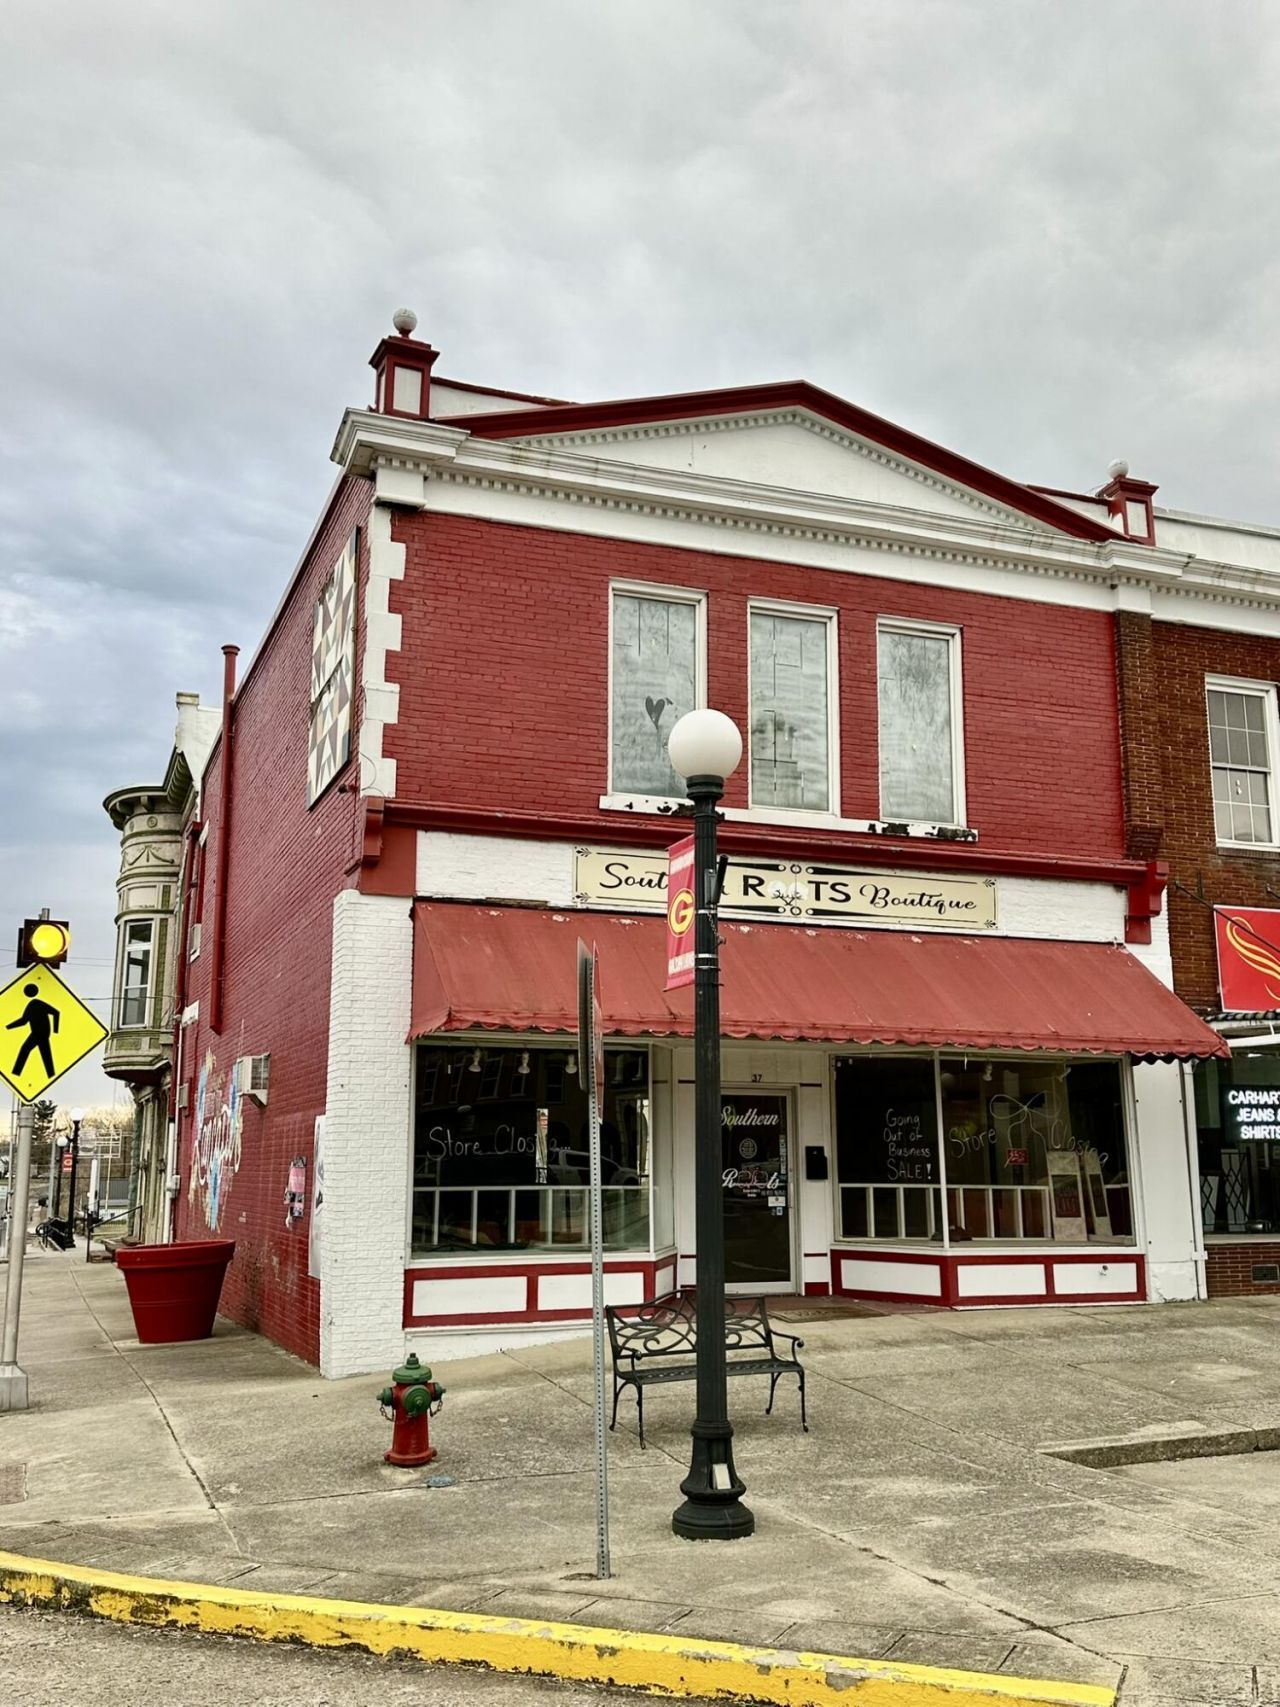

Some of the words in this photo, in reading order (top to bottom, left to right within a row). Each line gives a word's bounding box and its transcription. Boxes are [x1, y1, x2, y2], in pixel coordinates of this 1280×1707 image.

[859, 884, 977, 914] Boutique
[670, 892, 694, 933] G
[720, 1105, 779, 1126] Southern
[886, 1108, 920, 1127] Going
[1236, 1108, 1275, 1122] JEANS
[427, 1127, 481, 1161] Store
[883, 1127, 903, 1142] Out
[909, 1126, 923, 1141] of
[950, 1127, 998, 1158] Store
[887, 1158, 932, 1180] SALE!
